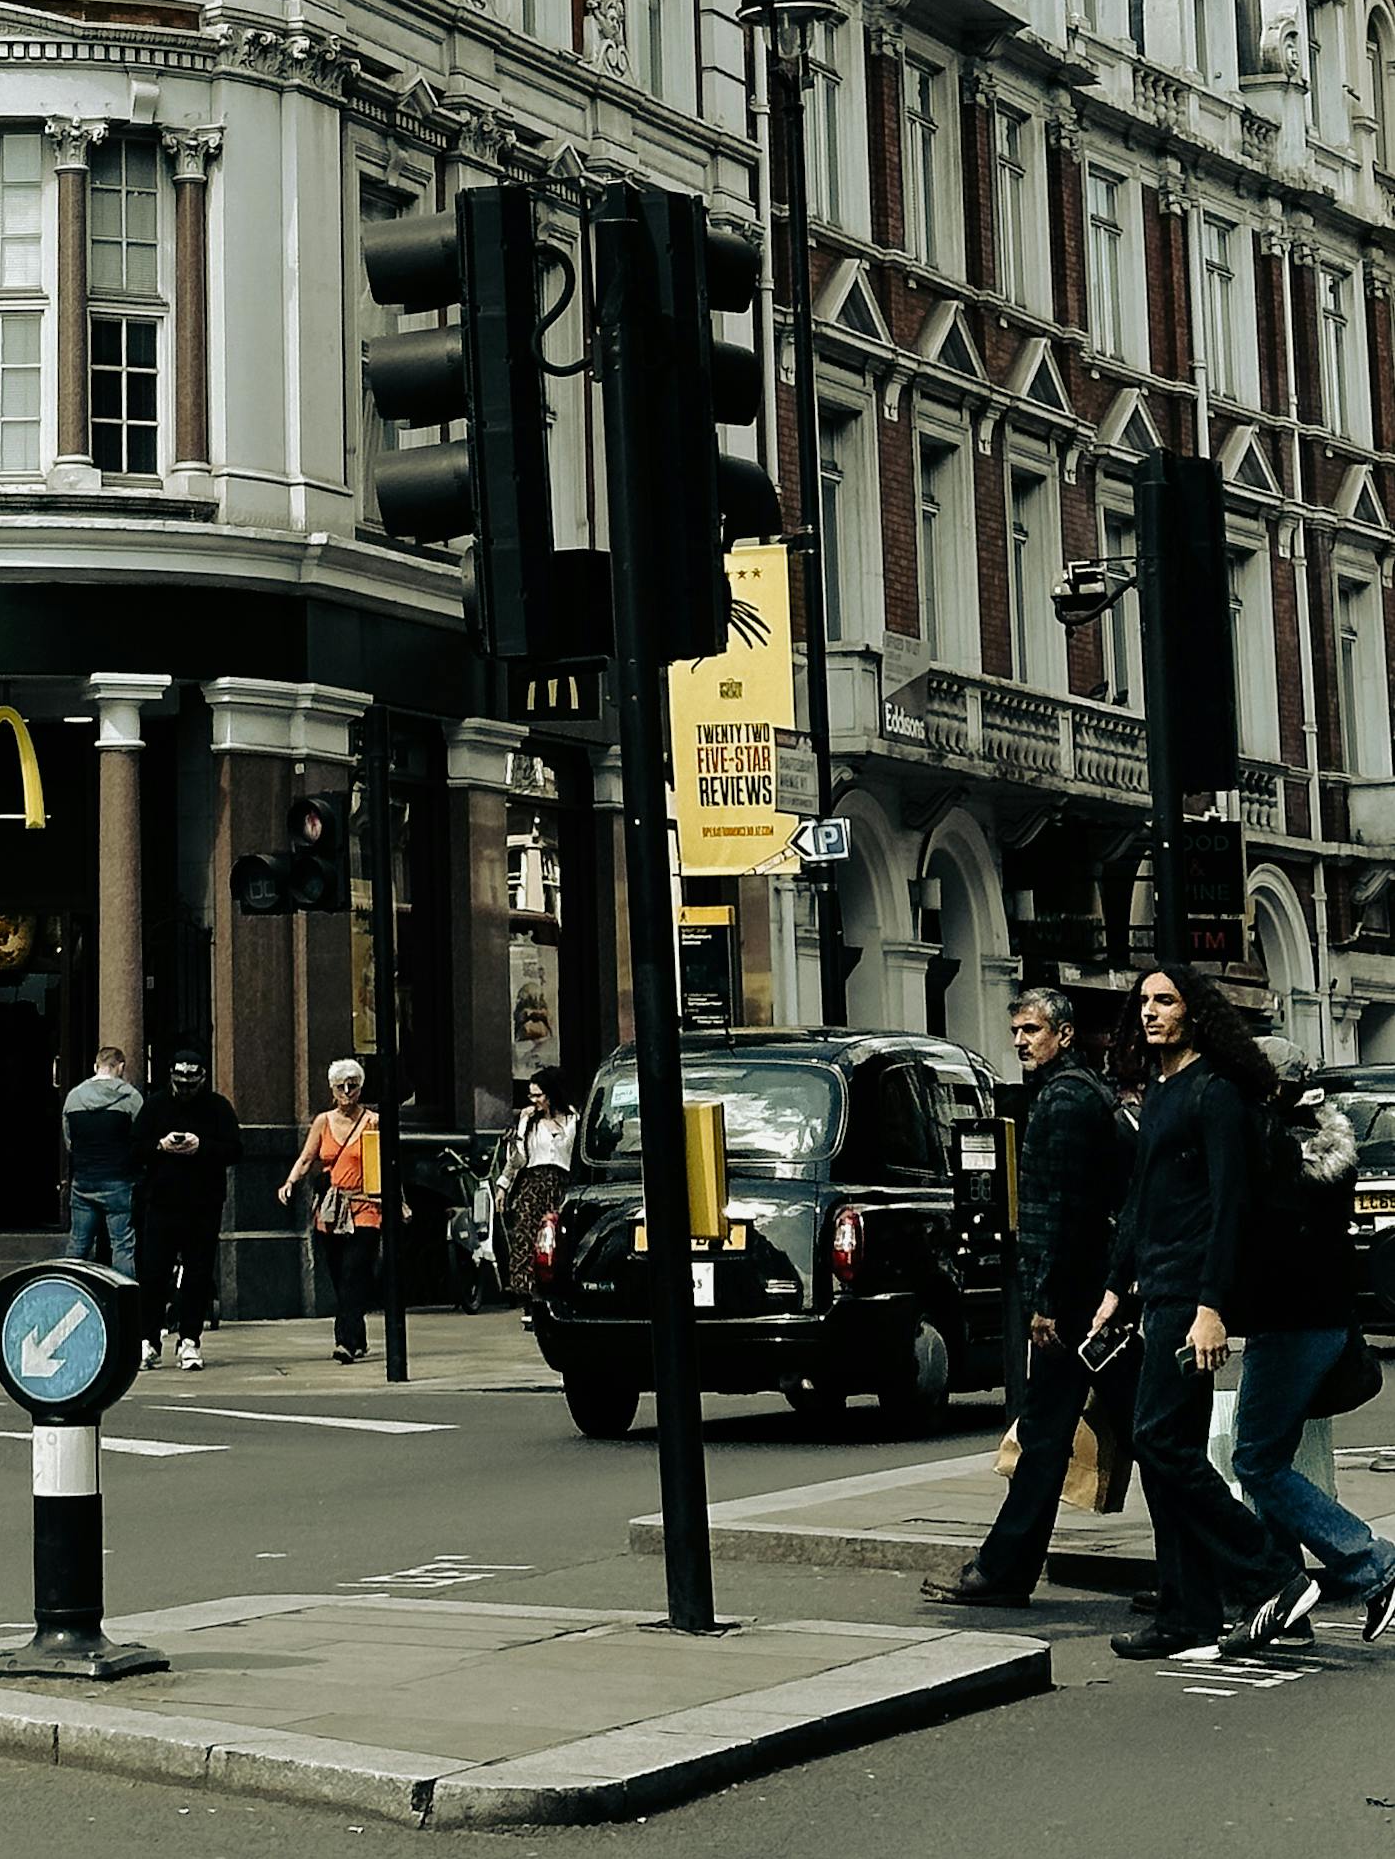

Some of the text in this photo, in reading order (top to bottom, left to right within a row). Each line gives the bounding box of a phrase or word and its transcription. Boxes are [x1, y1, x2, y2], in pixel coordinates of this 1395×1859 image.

[696, 722, 770, 745] TWENTY TWO
[885, 702, 926, 740] Eddisons
[696, 745, 771, 774] FIVE-STAR
[698, 775, 772, 807] REVIEWS
[818, 826, 840, 854] P
[1183, 834, 1229, 852] OOD
[1185, 883, 1230, 901] INE
[1190, 931, 1225, 949] TM
